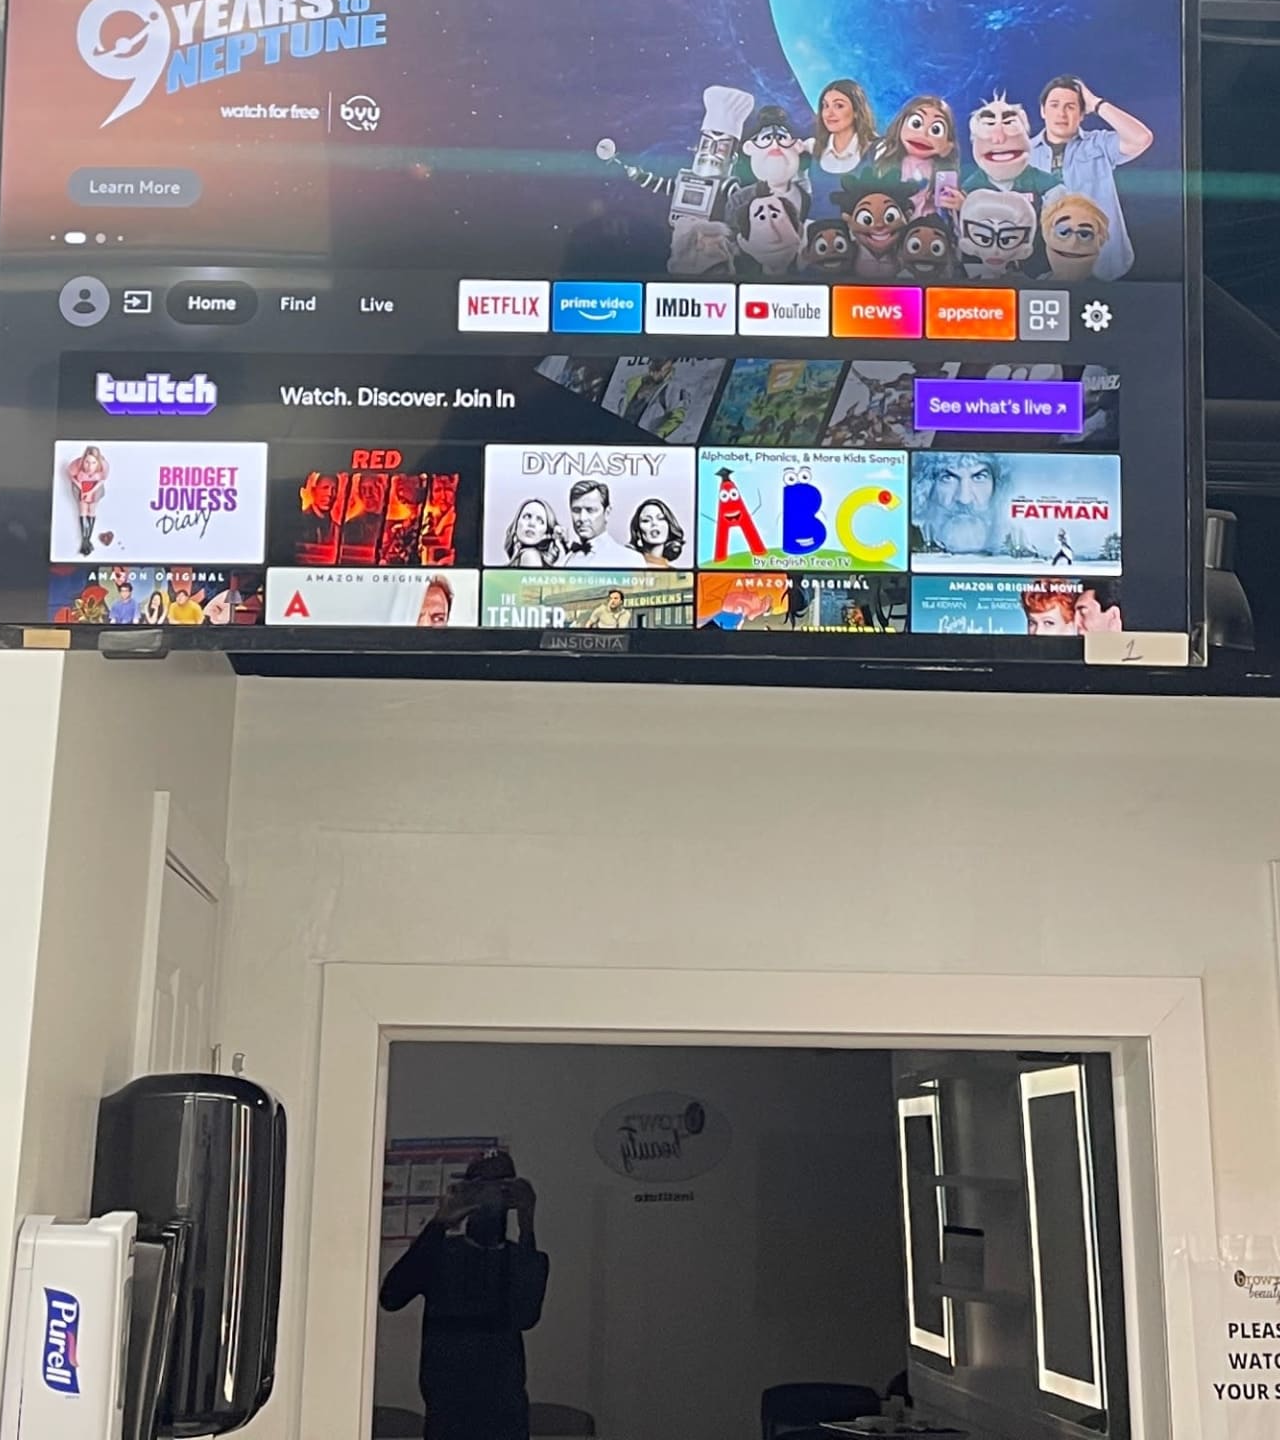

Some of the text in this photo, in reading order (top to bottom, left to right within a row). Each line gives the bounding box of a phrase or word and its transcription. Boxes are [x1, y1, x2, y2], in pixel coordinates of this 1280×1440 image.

[165, 13, 388, 95] NEPTUNE
[220, 104, 320, 120] watch for free
[89, 180, 180, 195] Learn More
[187, 295, 237, 311] Home
[280, 296, 317, 312] Find
[360, 297, 394, 313] Live
[467, 295, 540, 317] NETFLIX
[560, 298, 634, 311] prime video
[655, 297, 727, 319] IMDb TV
[771, 302, 821, 320] YouTube
[851, 303, 903, 320] news
[938, 304, 1004, 321] appstore
[96, 373, 218, 415] twitch
[280, 386, 516, 408] Watch. Discover. Join In
[929, 398, 1052, 416] See what's live
[351, 449, 402, 470] RED
[522, 451, 666, 476] DYNASTY
[701, 450, 905, 466] Alphabet, Phonics, & More Kids Songs!
[159, 466, 239, 487] BRIDGET
[1011, 504, 1109, 520] FATMAN
[155, 508, 212, 539] Diary
[753, 557, 850, 569] by English Tree TV
[88, 571, 224, 582] AMAZON ORIGINAL
[306, 574, 439, 584] AMAZON ORIGINAL
[521, 576, 655, 587] AMAZON ORIGINAL MOVIE
[735, 578, 869, 590] AMAZON ORIGINAL
[949, 581, 1084, 594] AMAZON ORIGINAL MOVIE
[550, 636, 623, 649] INSIGNIA
[45, 1299, 78, 1386] Purell
[1213, 1383, 1270, 1400] YOUR
